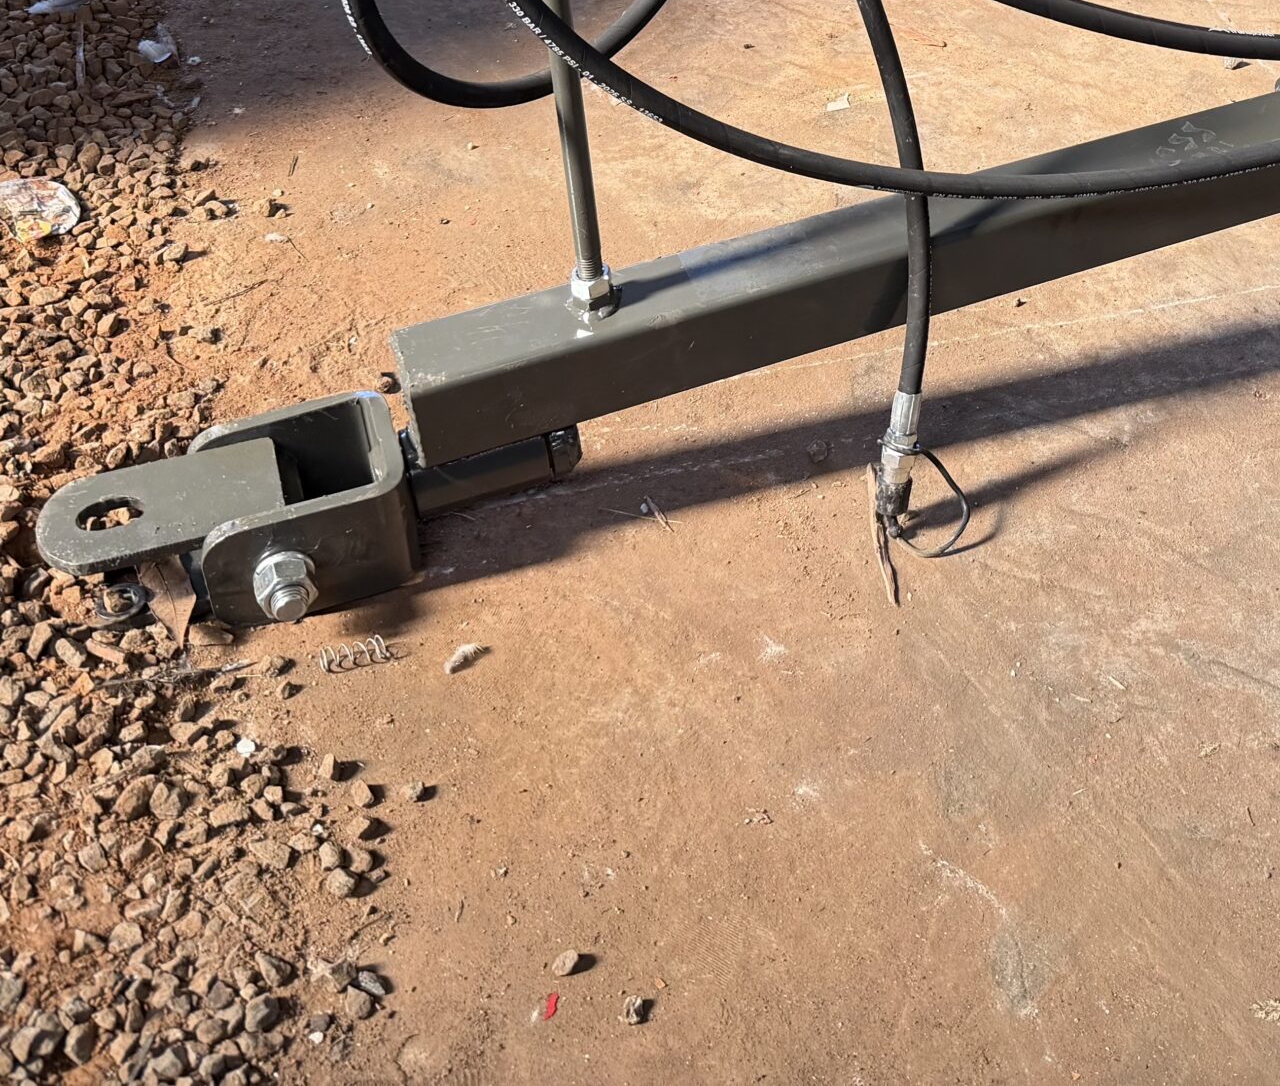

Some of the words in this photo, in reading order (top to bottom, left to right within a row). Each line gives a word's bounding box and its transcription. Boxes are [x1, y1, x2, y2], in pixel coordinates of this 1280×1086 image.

[508, 1, 524, 17] 330
[521, 16, 542, 35] BAR
[543, 39, 565, 56] 4785
[562, 55, 579, 68] PSI
[582, 70, 594, 79] 01
